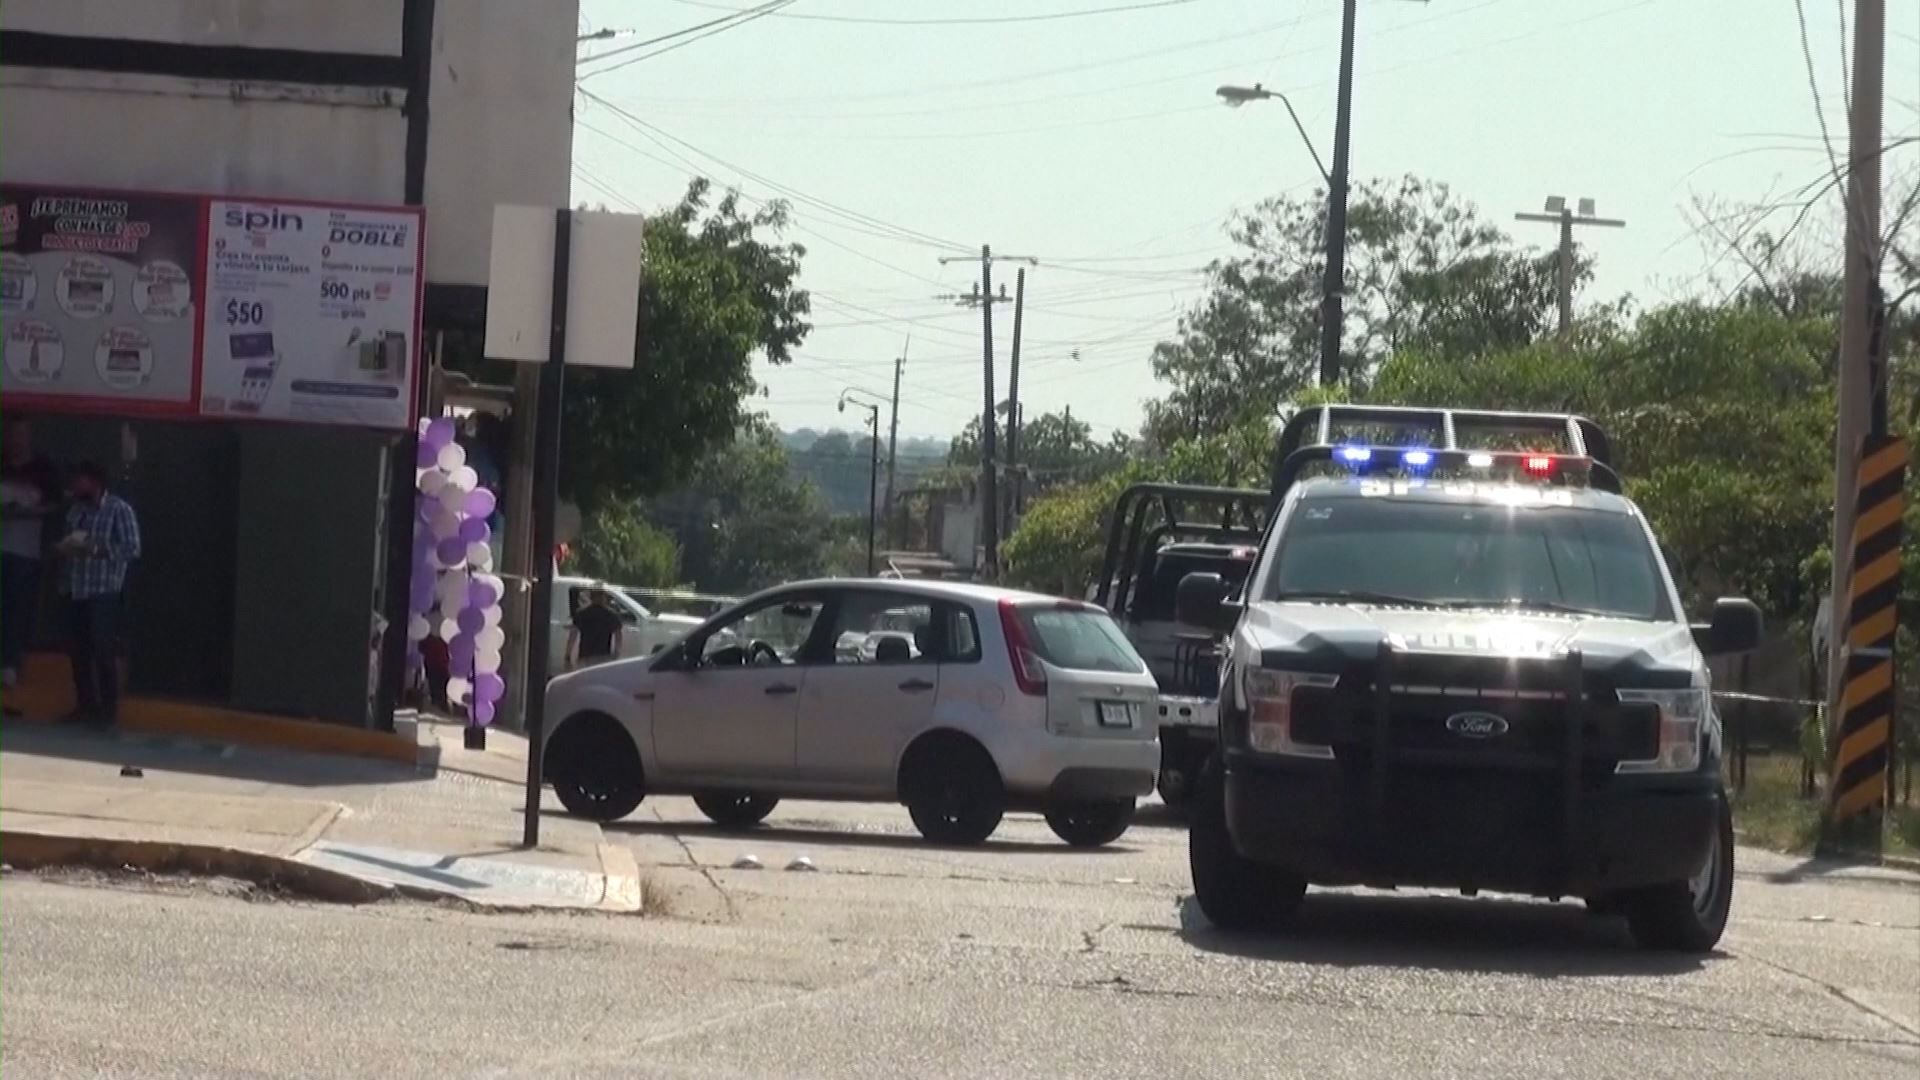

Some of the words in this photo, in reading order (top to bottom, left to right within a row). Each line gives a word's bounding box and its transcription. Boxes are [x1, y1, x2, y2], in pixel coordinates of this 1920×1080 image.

[57, 199, 128, 217] PREMIAMOS
[225, 208, 303, 231] spin
[328, 228, 406, 248] DOBLE
[321, 281, 349, 299] 500
[352, 289, 371, 302] pts
[227, 298, 263, 325] $50
[1460, 717, 1494, 733] Ford
